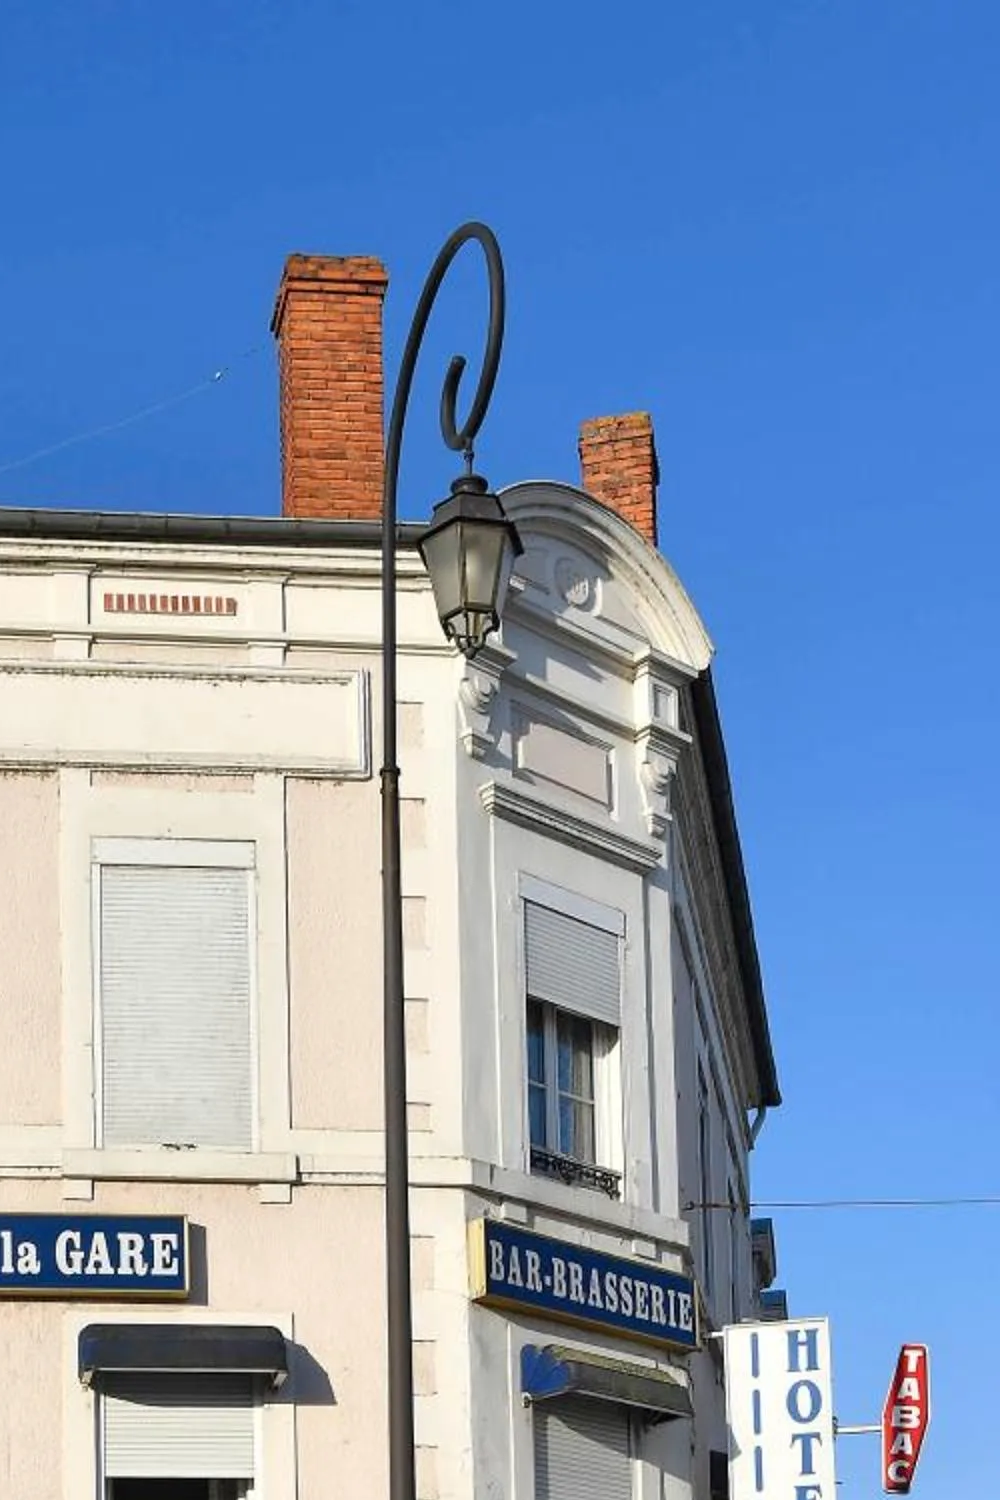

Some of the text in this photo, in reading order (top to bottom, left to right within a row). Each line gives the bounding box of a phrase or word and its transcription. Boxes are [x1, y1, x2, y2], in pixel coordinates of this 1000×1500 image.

[0, 1230, 40, 1275] la
[55, 1231, 179, 1277] GARE
[489, 1239, 693, 1333] BAR-BRASSERIE
[888, 1350, 924, 1484] TABAC
